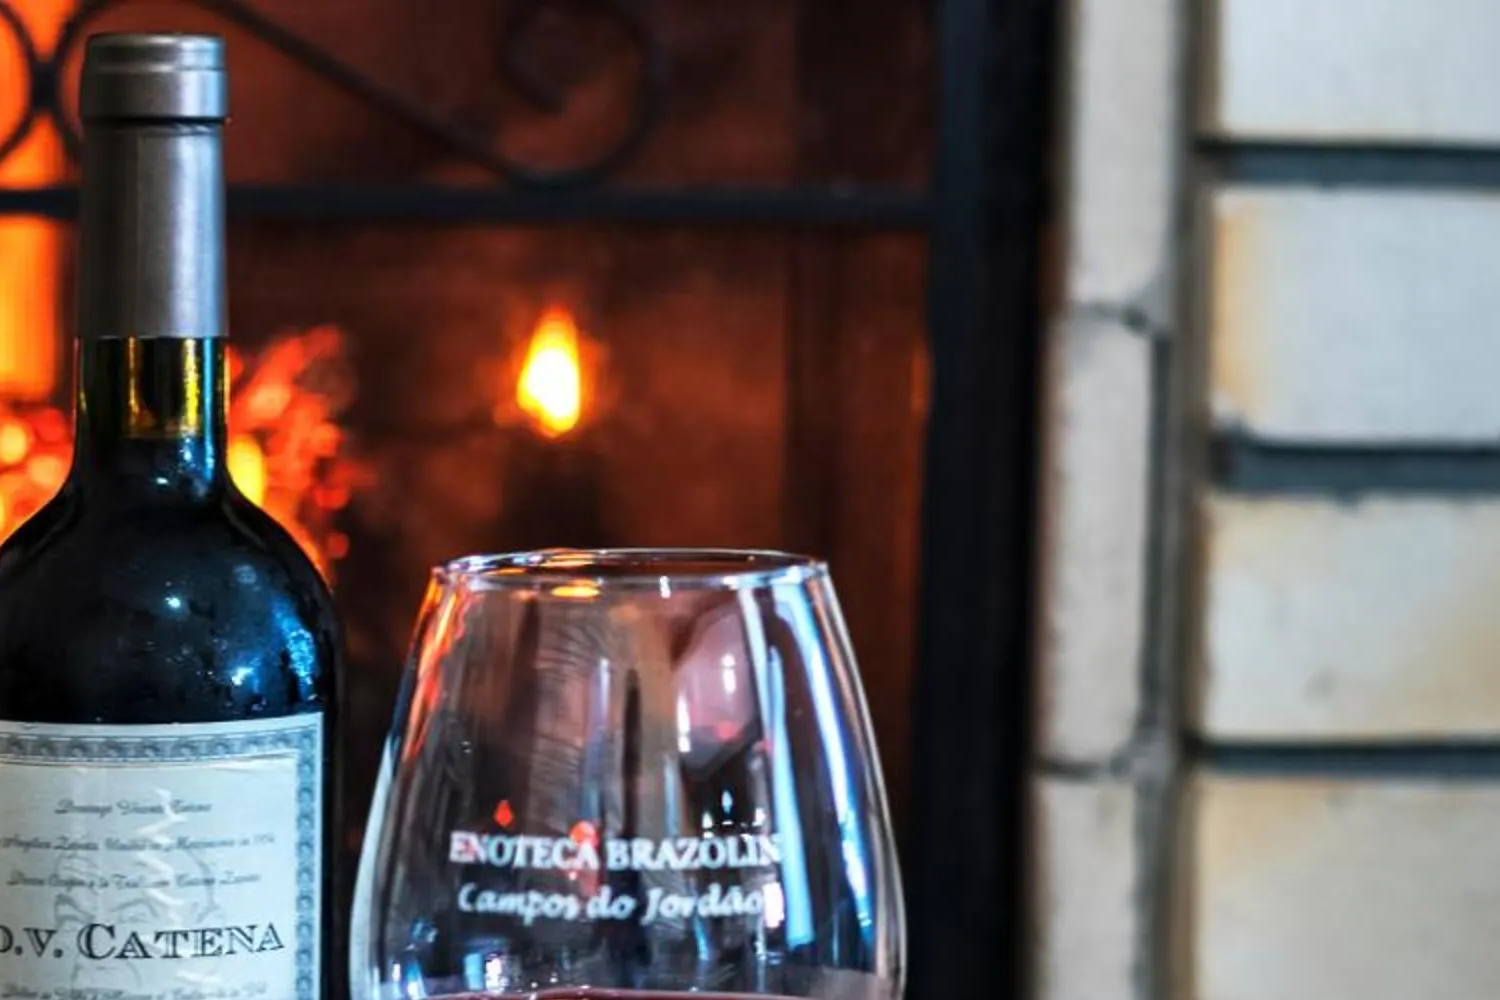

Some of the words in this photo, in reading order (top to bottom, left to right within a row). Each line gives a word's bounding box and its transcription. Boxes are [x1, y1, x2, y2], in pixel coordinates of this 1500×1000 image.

[449, 831, 600, 869] ENOTECA
[607, 833, 784, 870] BRAZOLIN
[457, 882, 581, 925] Campos
[586, 885, 637, 919] do
[76, 922, 285, 960] CATENA
